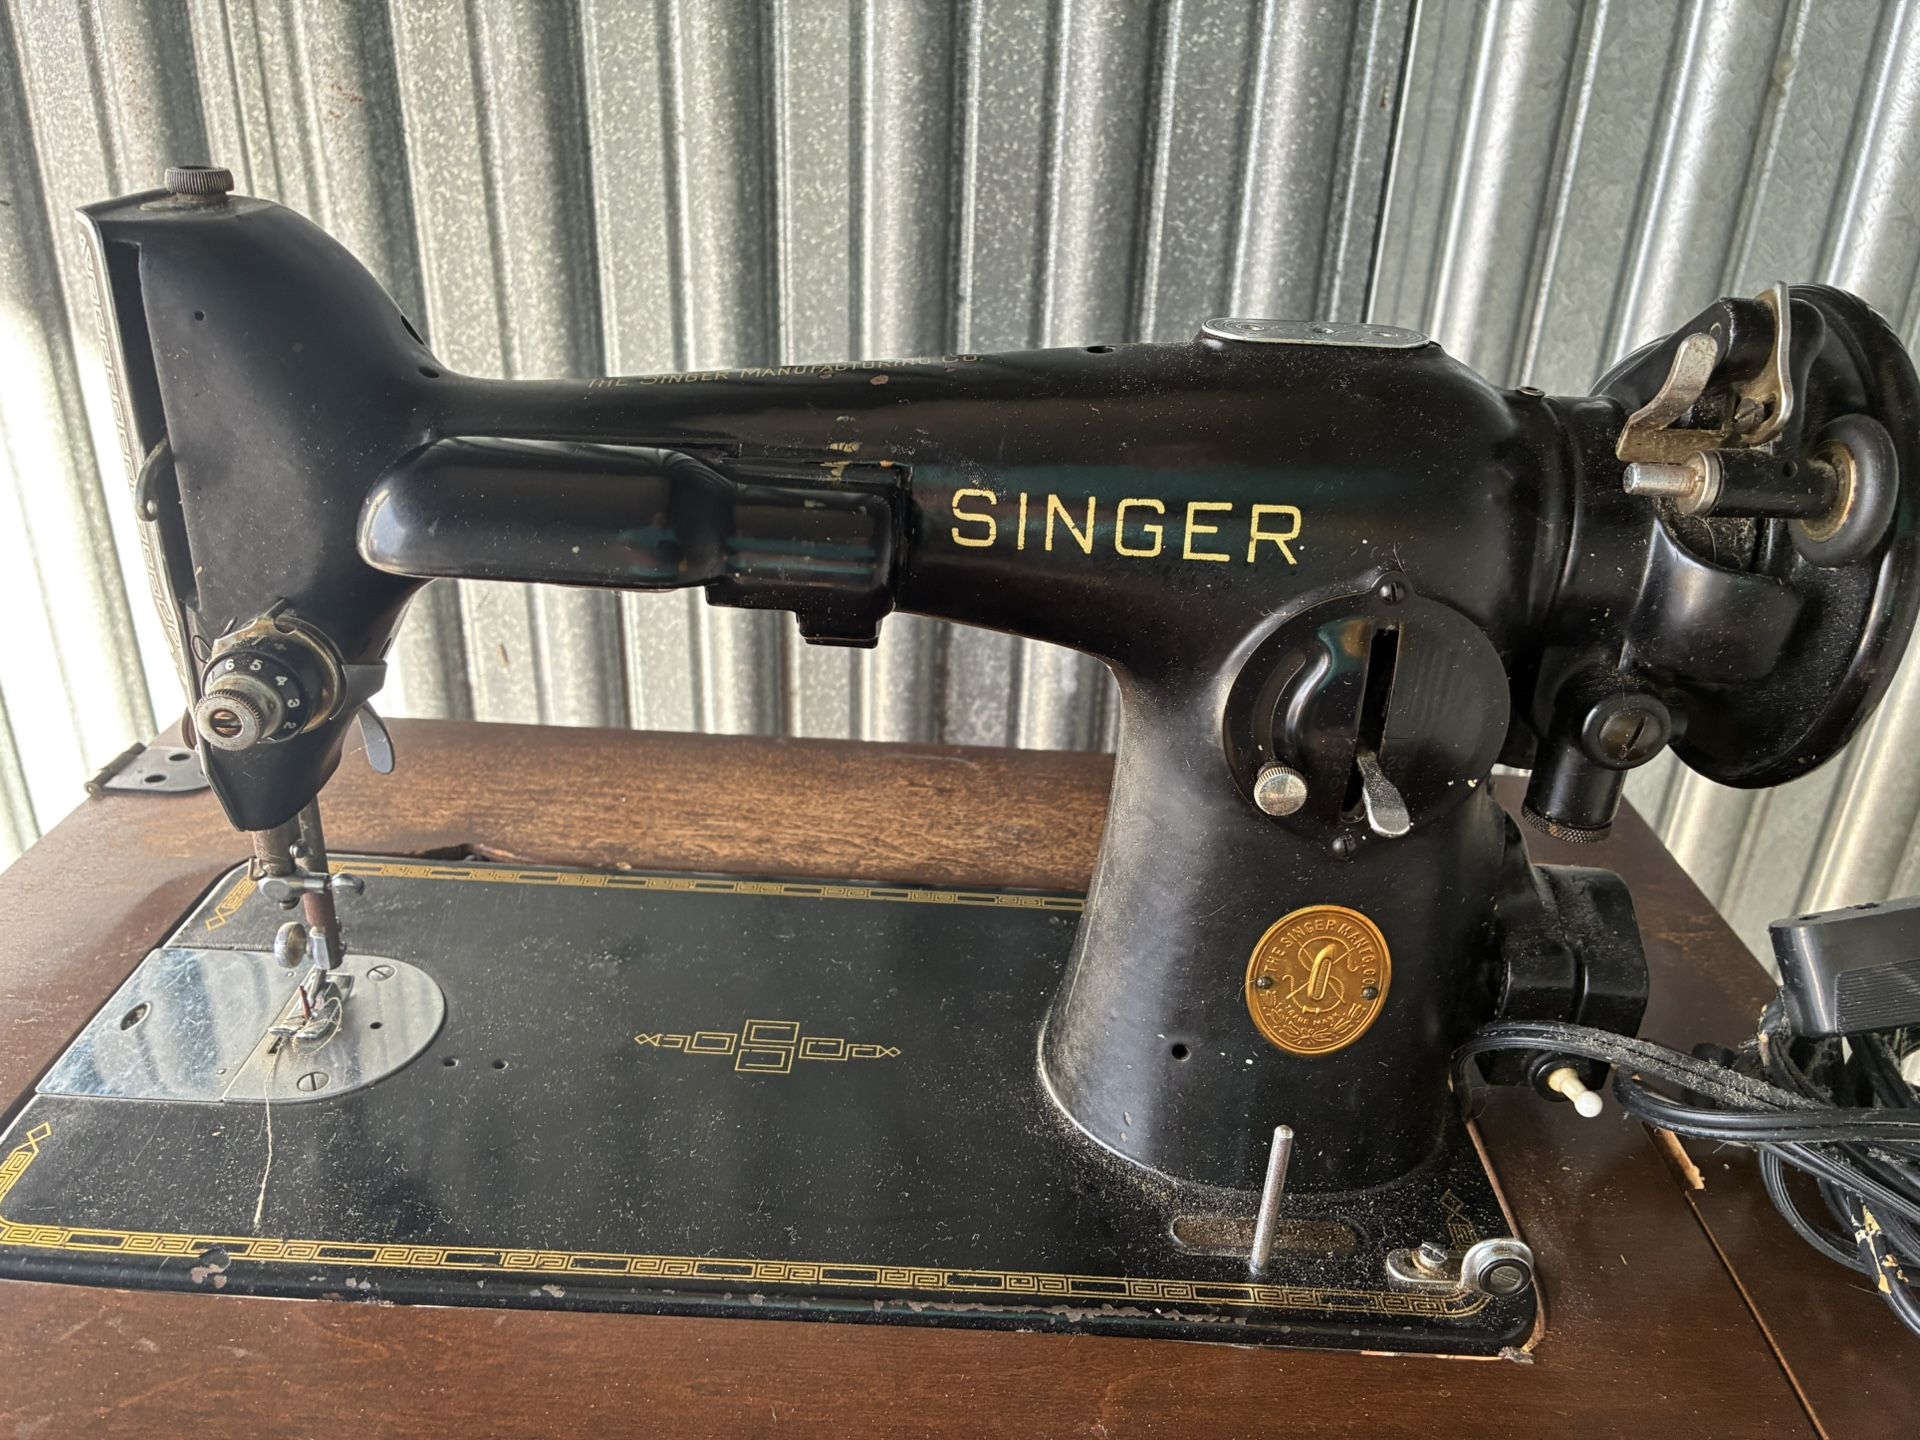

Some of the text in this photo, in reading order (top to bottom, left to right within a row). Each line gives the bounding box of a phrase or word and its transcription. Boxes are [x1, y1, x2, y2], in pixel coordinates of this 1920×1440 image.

[640, 371, 729, 386] SINGER
[952, 488, 1301, 565] SINGER
[225, 659, 235, 671] 6
[250, 660, 263, 671] 5
[275, 676, 288, 686] 4
[287, 698, 300, 708] 3
[283, 721, 297, 730] 2
[1264, 947, 1286, 972] THE
[1280, 919, 1337, 948] SINGER
[1285, 1004, 1309, 1024] TRADE
